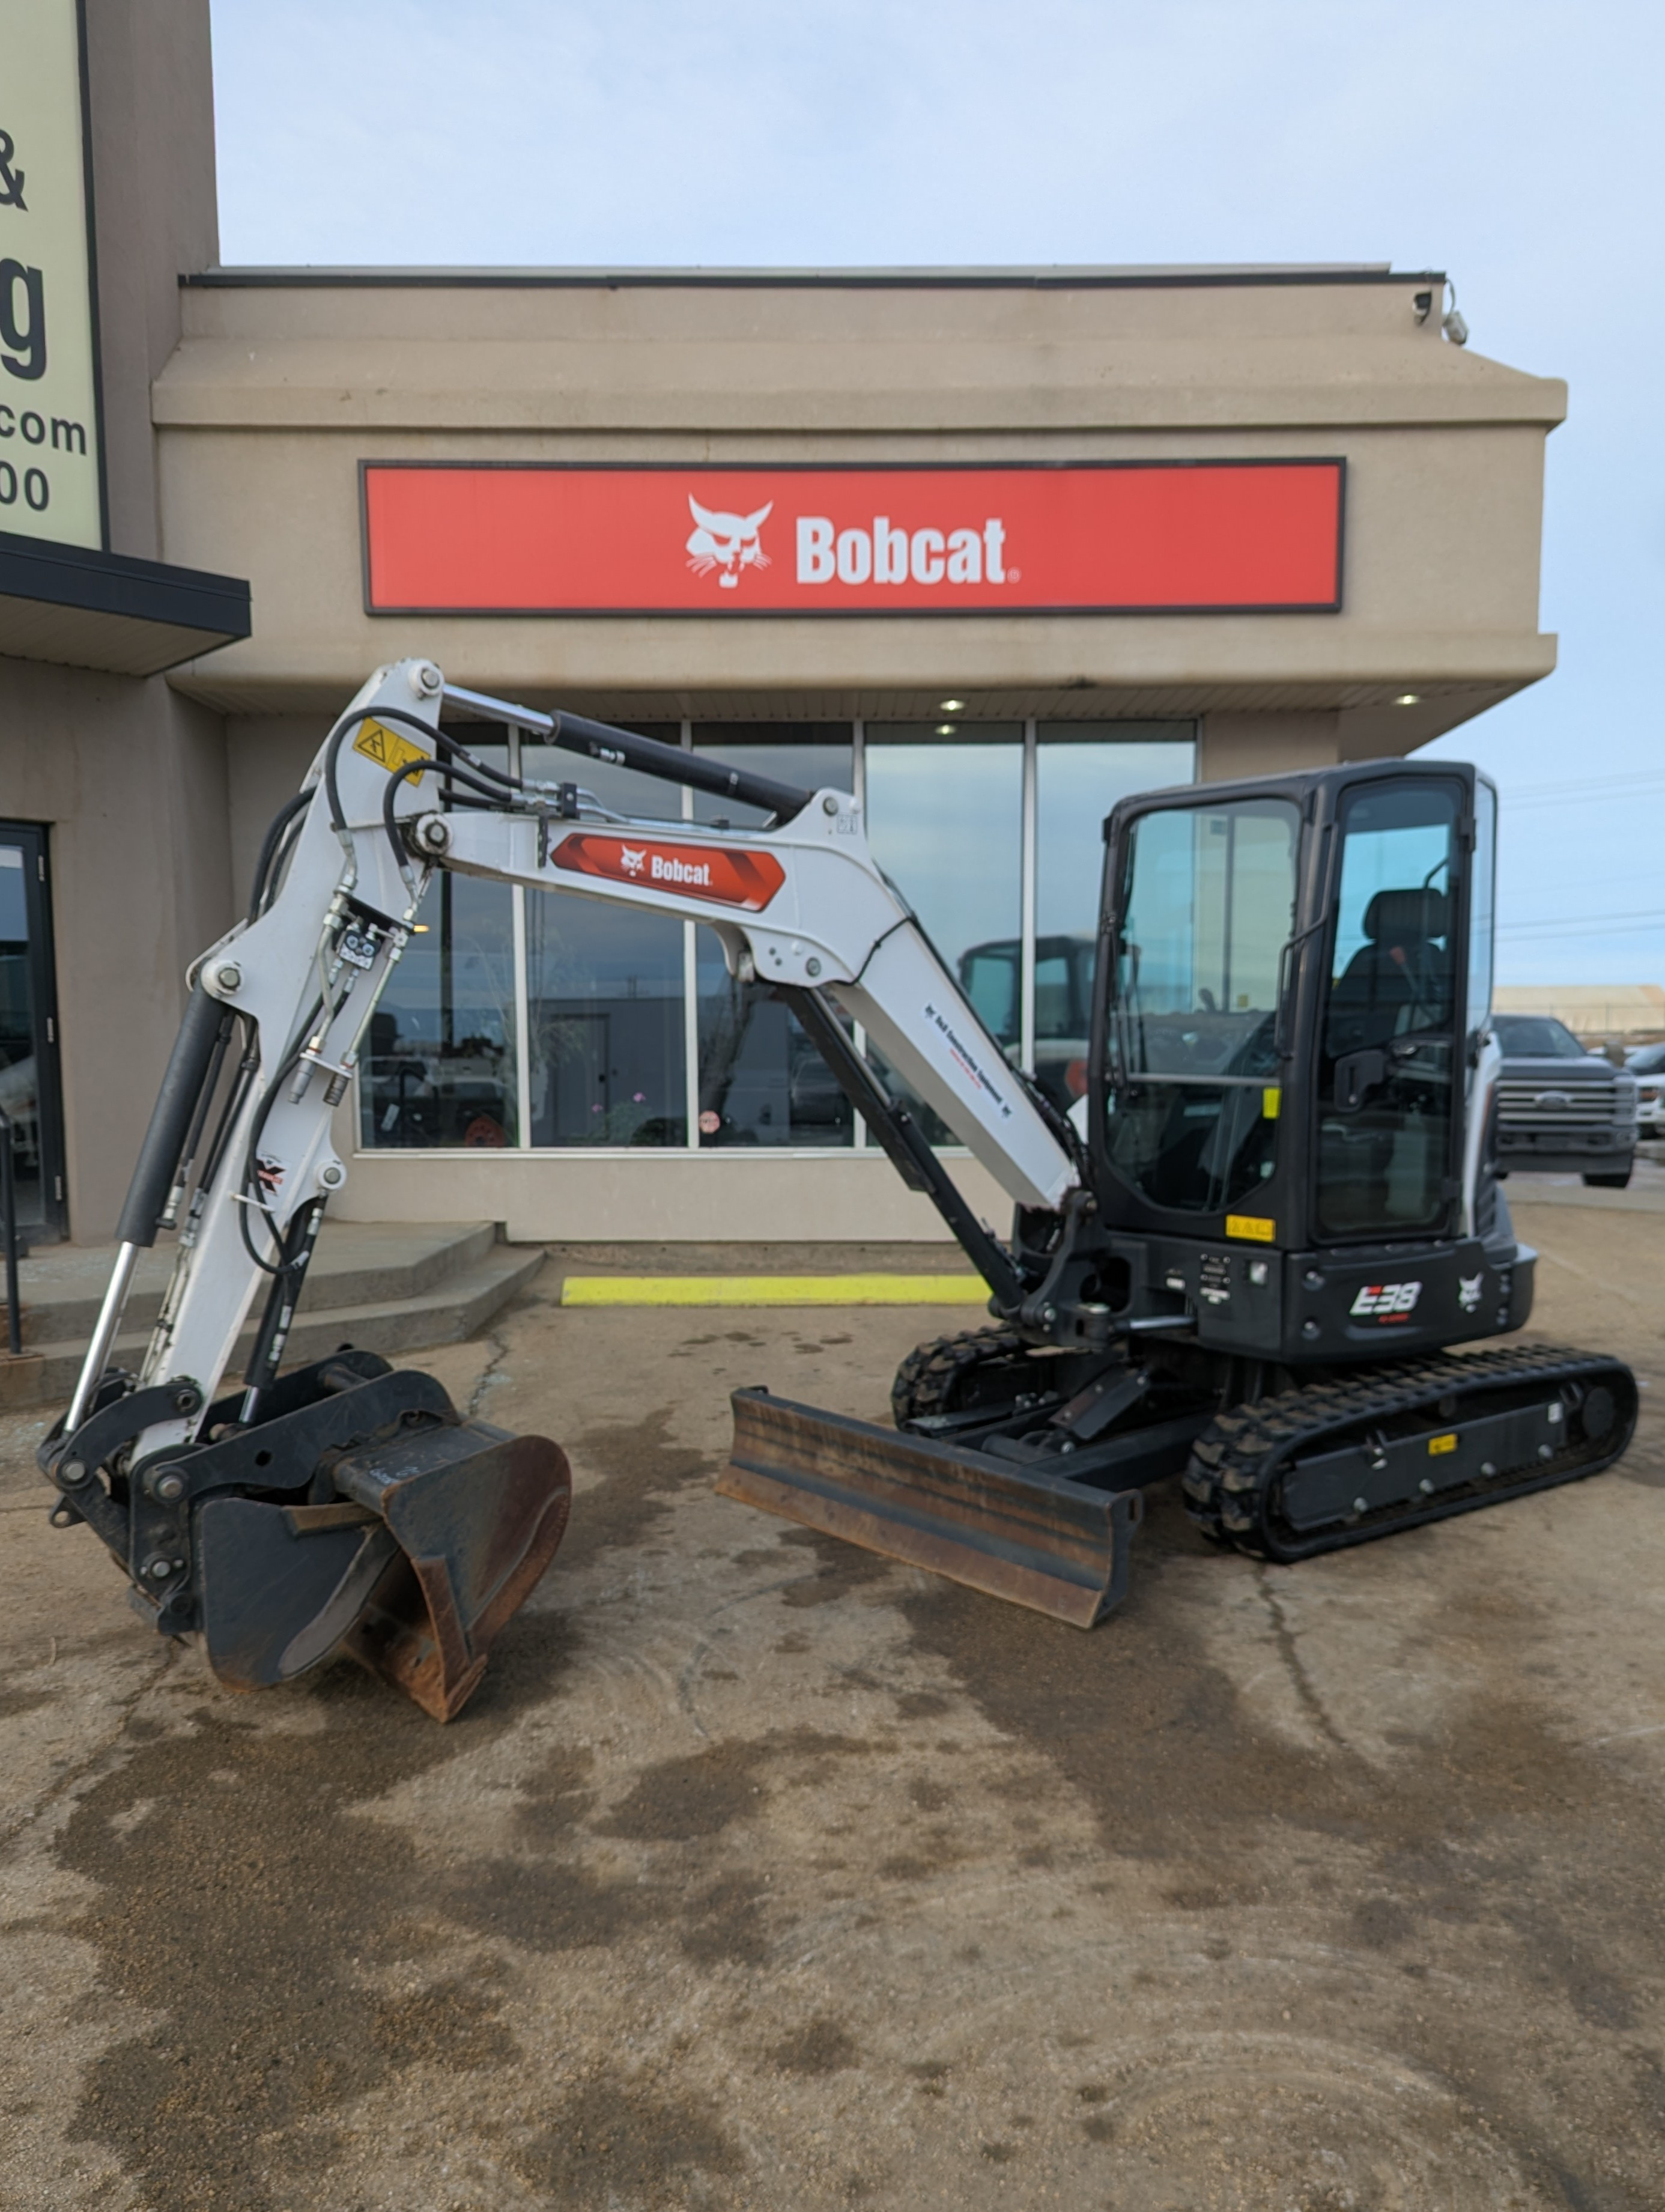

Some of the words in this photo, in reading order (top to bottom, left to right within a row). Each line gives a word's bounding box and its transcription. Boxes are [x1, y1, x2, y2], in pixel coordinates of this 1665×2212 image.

[0, 129, 28, 212] &
[796, 516, 1005, 585] Bobcat
[651, 854, 710, 886] Bobcat
[1350, 1281, 1422, 1316] E38
